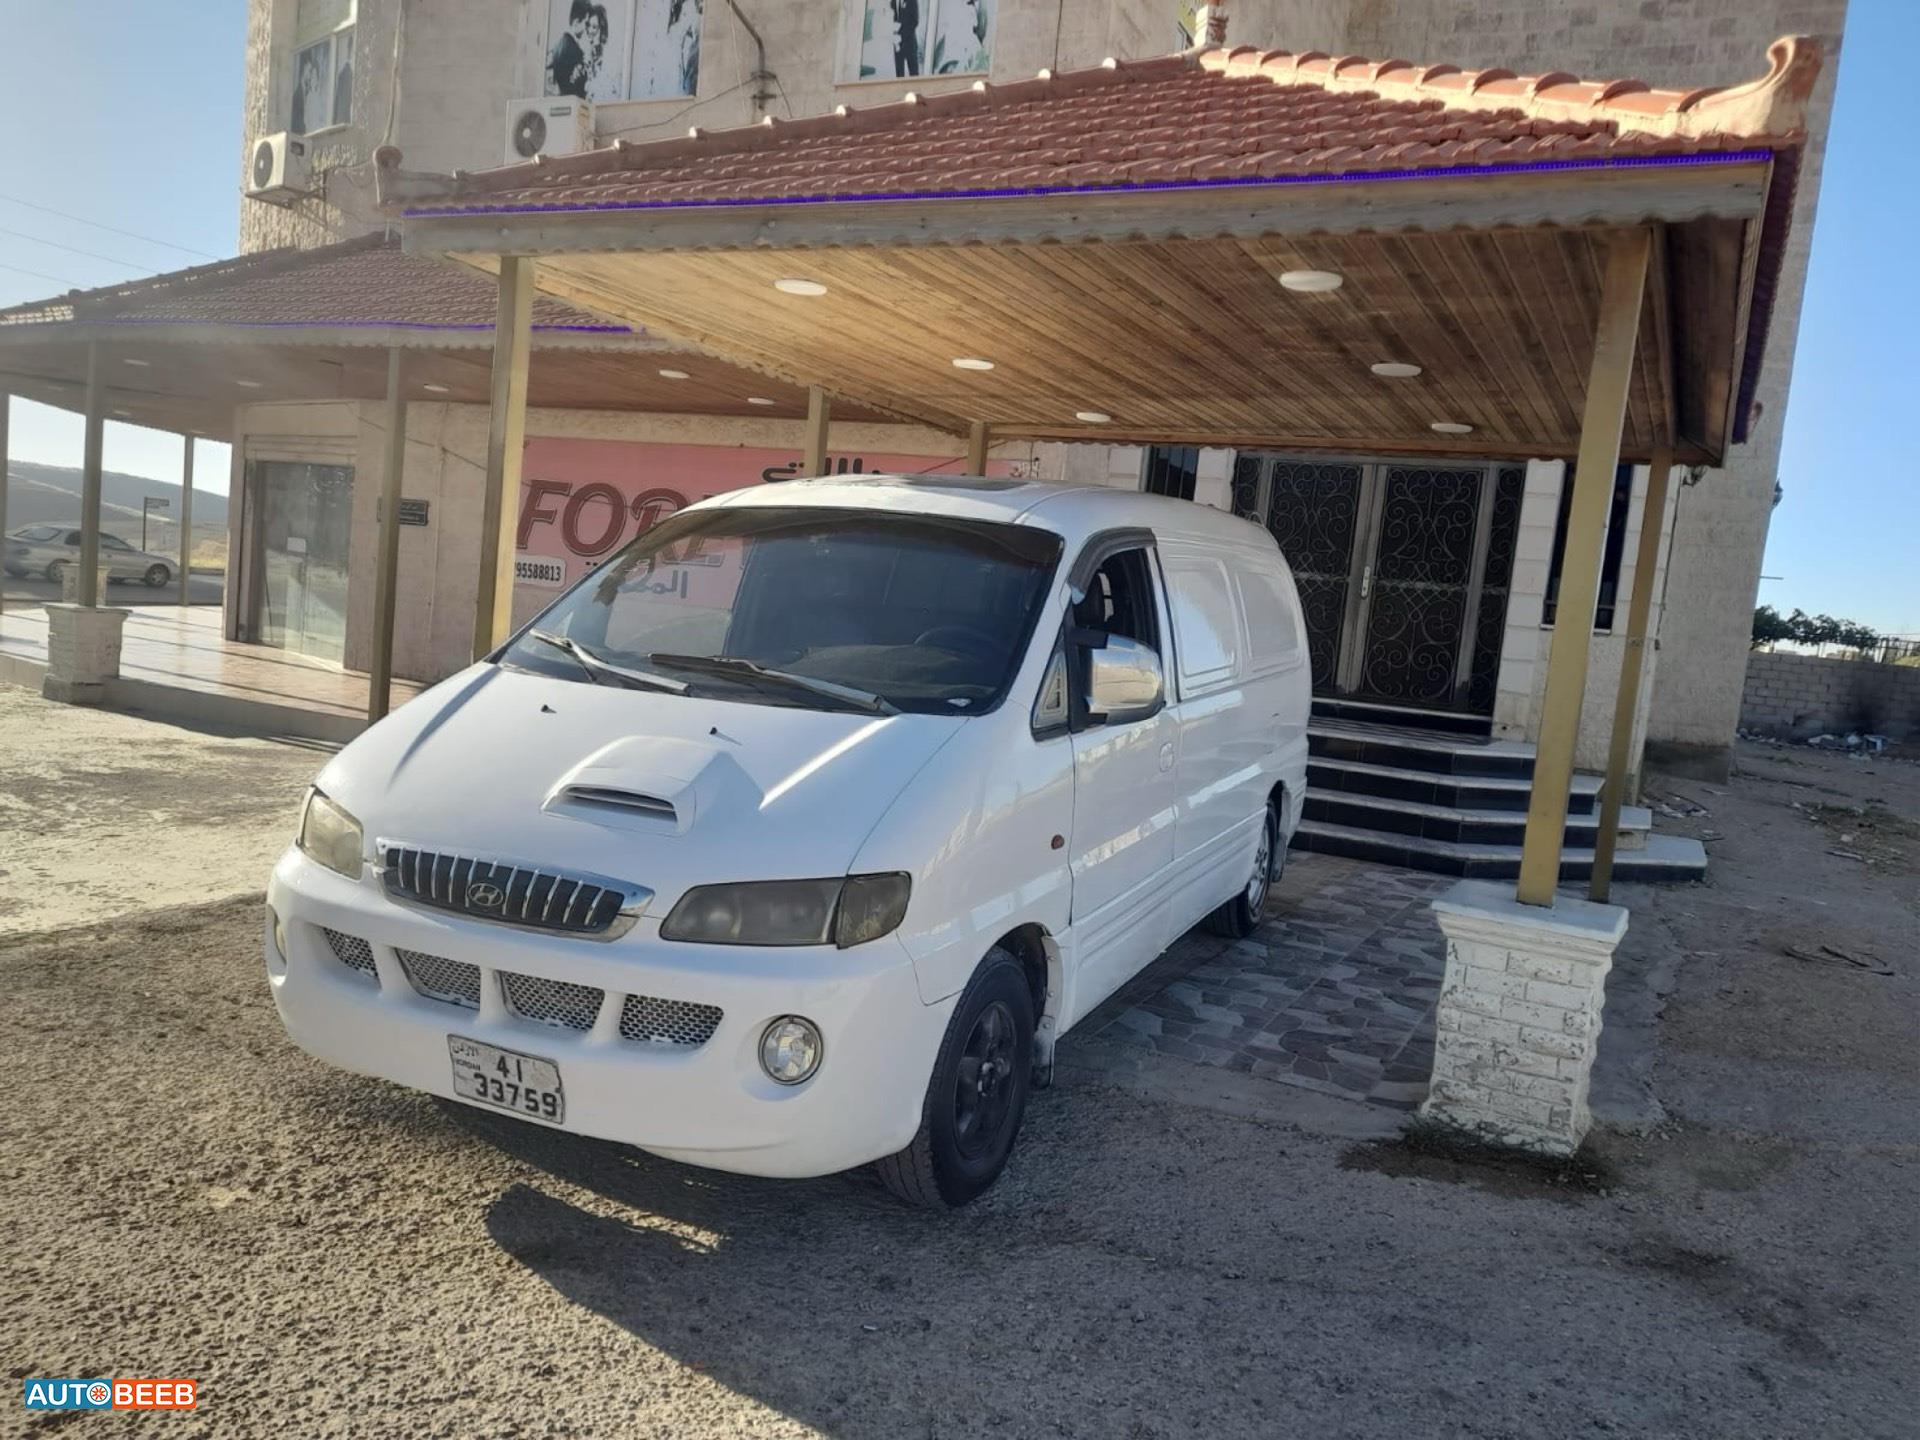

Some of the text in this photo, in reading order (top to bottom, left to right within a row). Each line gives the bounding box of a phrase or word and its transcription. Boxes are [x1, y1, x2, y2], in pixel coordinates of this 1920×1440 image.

[514, 561, 561, 581] 95588813
[496, 1055, 523, 1083] 41
[473, 1072, 558, 1117] 33759
